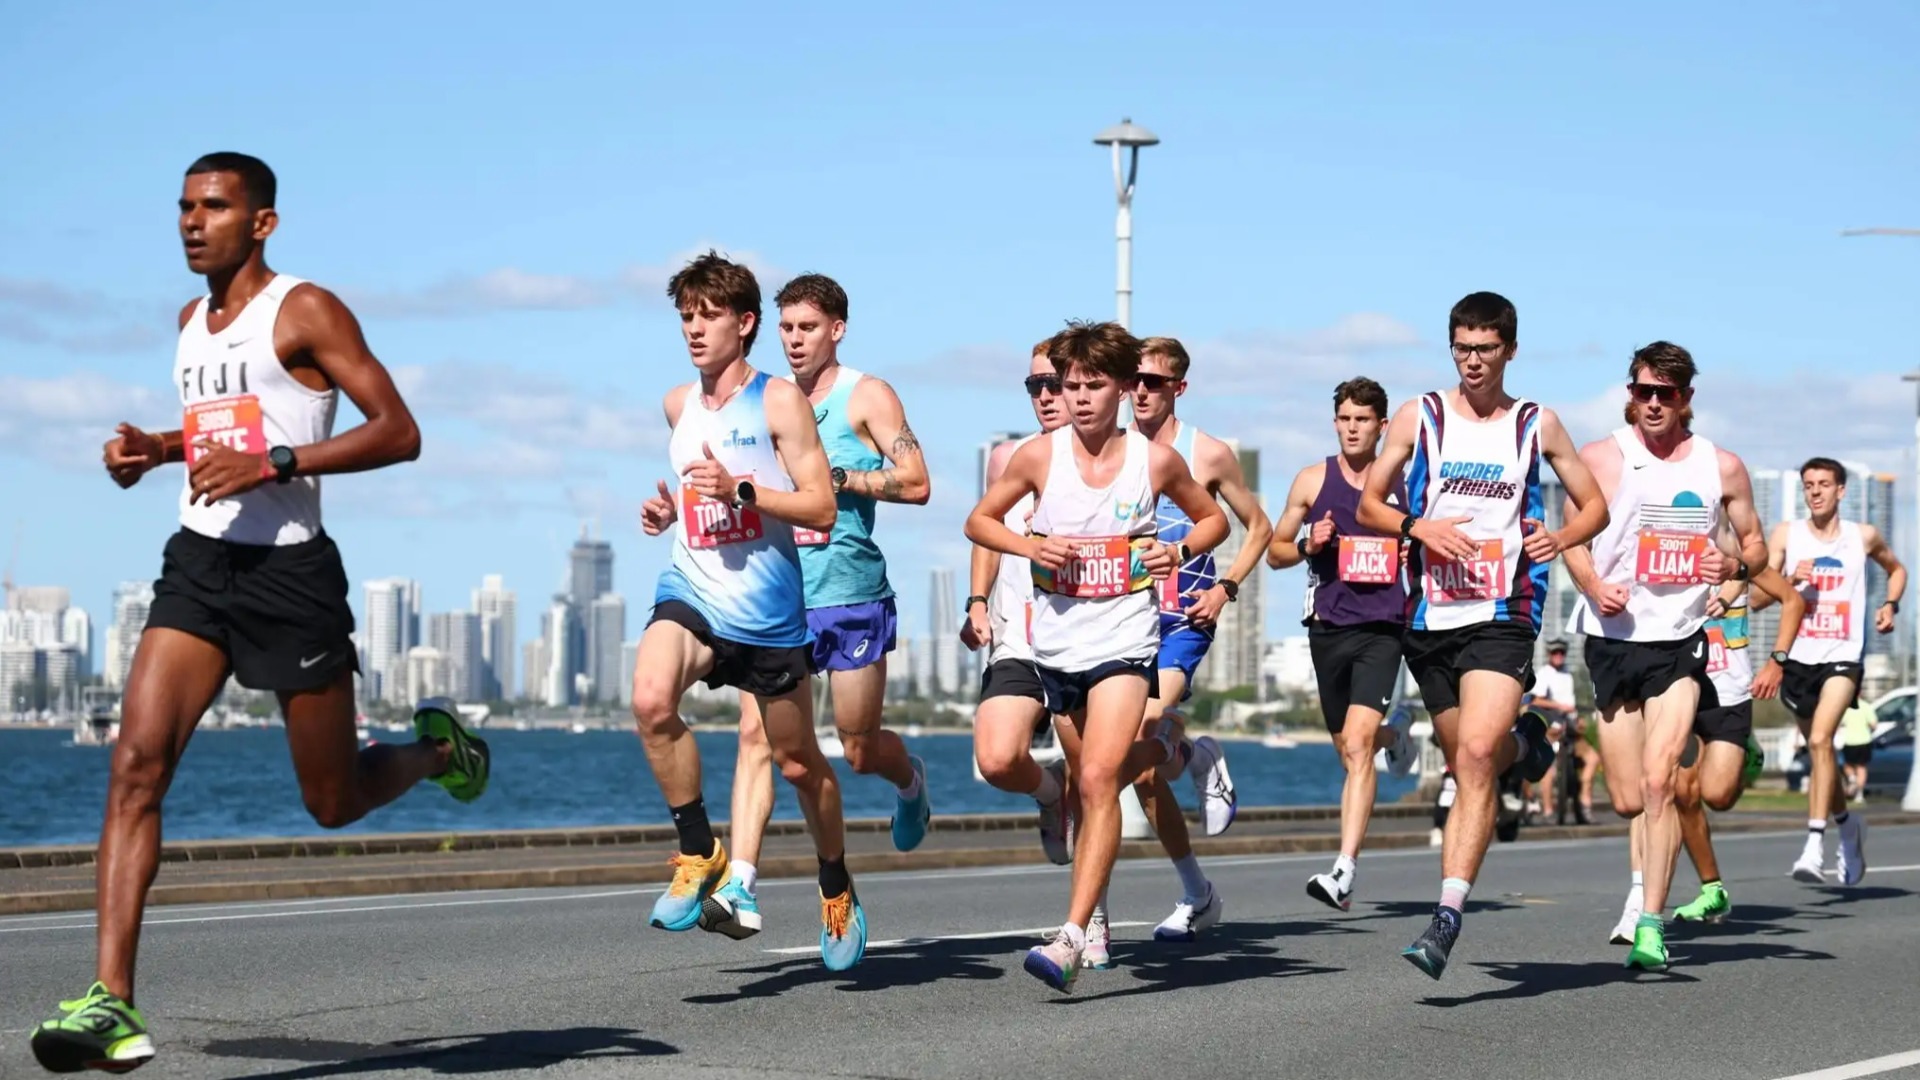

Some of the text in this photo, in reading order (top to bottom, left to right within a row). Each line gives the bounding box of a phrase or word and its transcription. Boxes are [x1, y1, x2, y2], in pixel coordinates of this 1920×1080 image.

[183, 362, 248, 400] FIJI
[1439, 461, 1505, 481] BORDER
[1440, 477, 1517, 500] STRIDERS
[693, 502, 744, 534] TOBY
[1075, 543, 1106, 558] 0013
[1659, 538, 1689, 552] 50011
[1057, 557, 1125, 586] MOORE
[1346, 553, 1389, 575] JACK
[1430, 560, 1500, 591] BAILEY
[1648, 550, 1695, 577] LIAM
